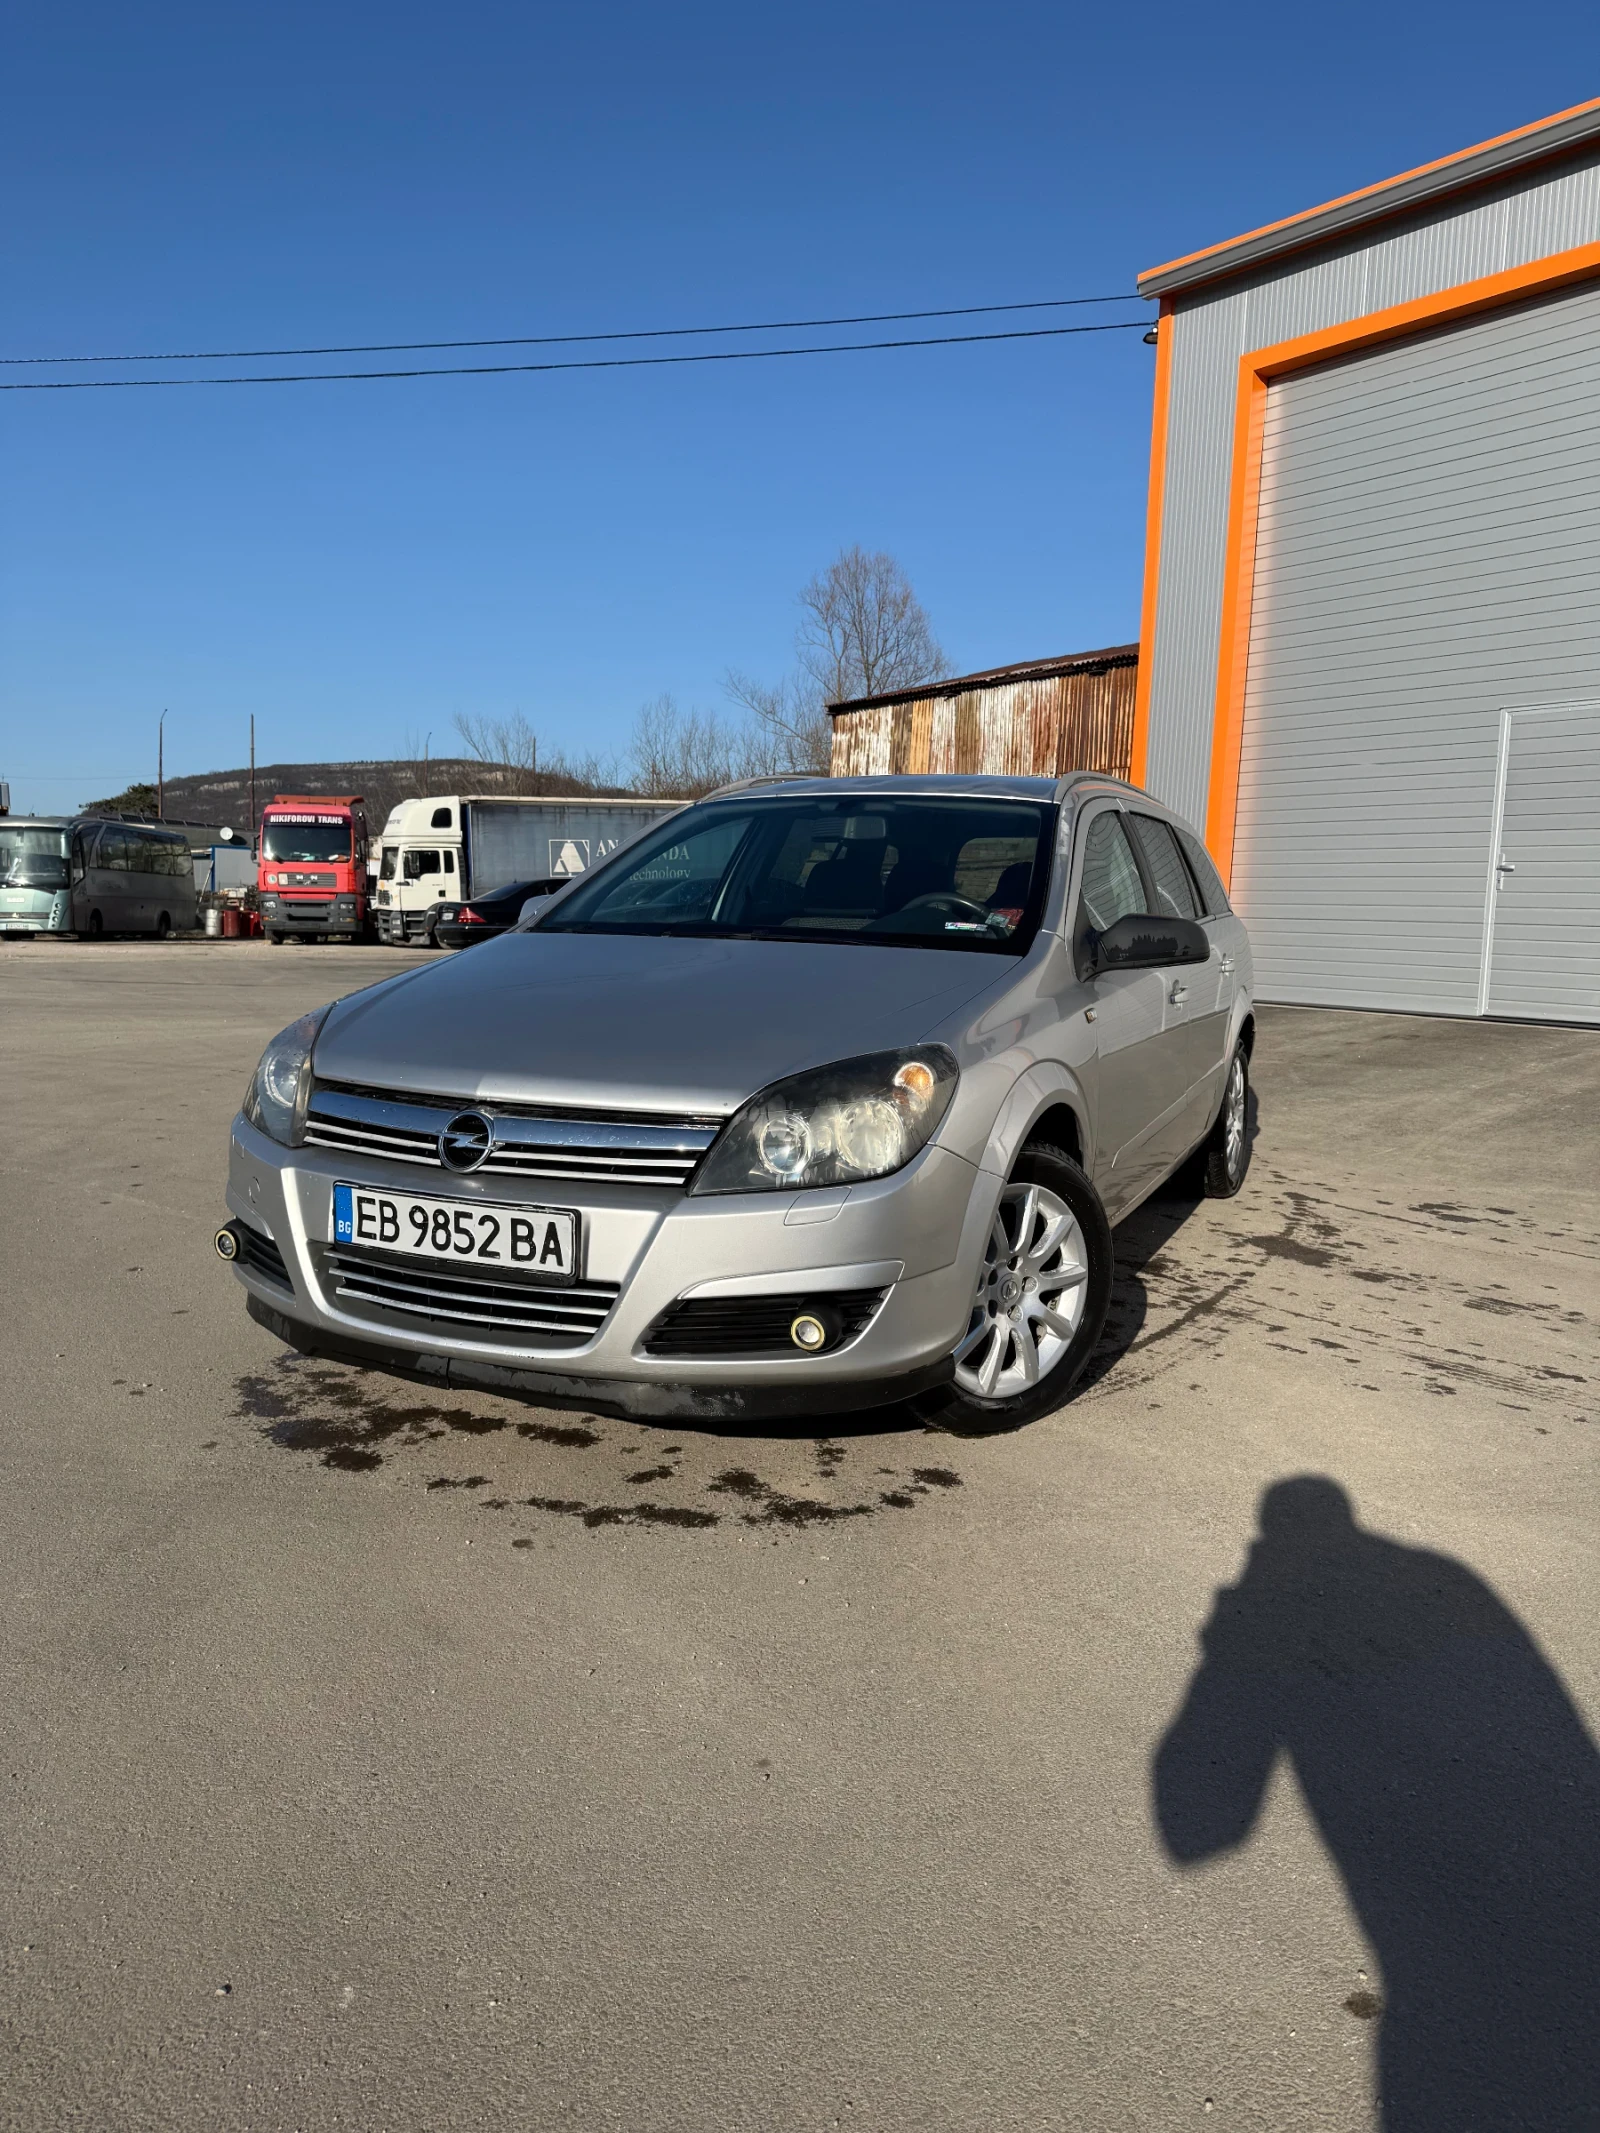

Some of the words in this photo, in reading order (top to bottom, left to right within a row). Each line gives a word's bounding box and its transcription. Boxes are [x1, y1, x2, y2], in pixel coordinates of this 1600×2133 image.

[270, 814, 315, 823] NIKIFOROVI
[317, 815, 343, 824] TRANS
[338, 1220, 351, 1234] BG
[356, 1195, 400, 1243] EB
[408, 1204, 501, 1259] 9852
[510, 1217, 564, 1267] BA
